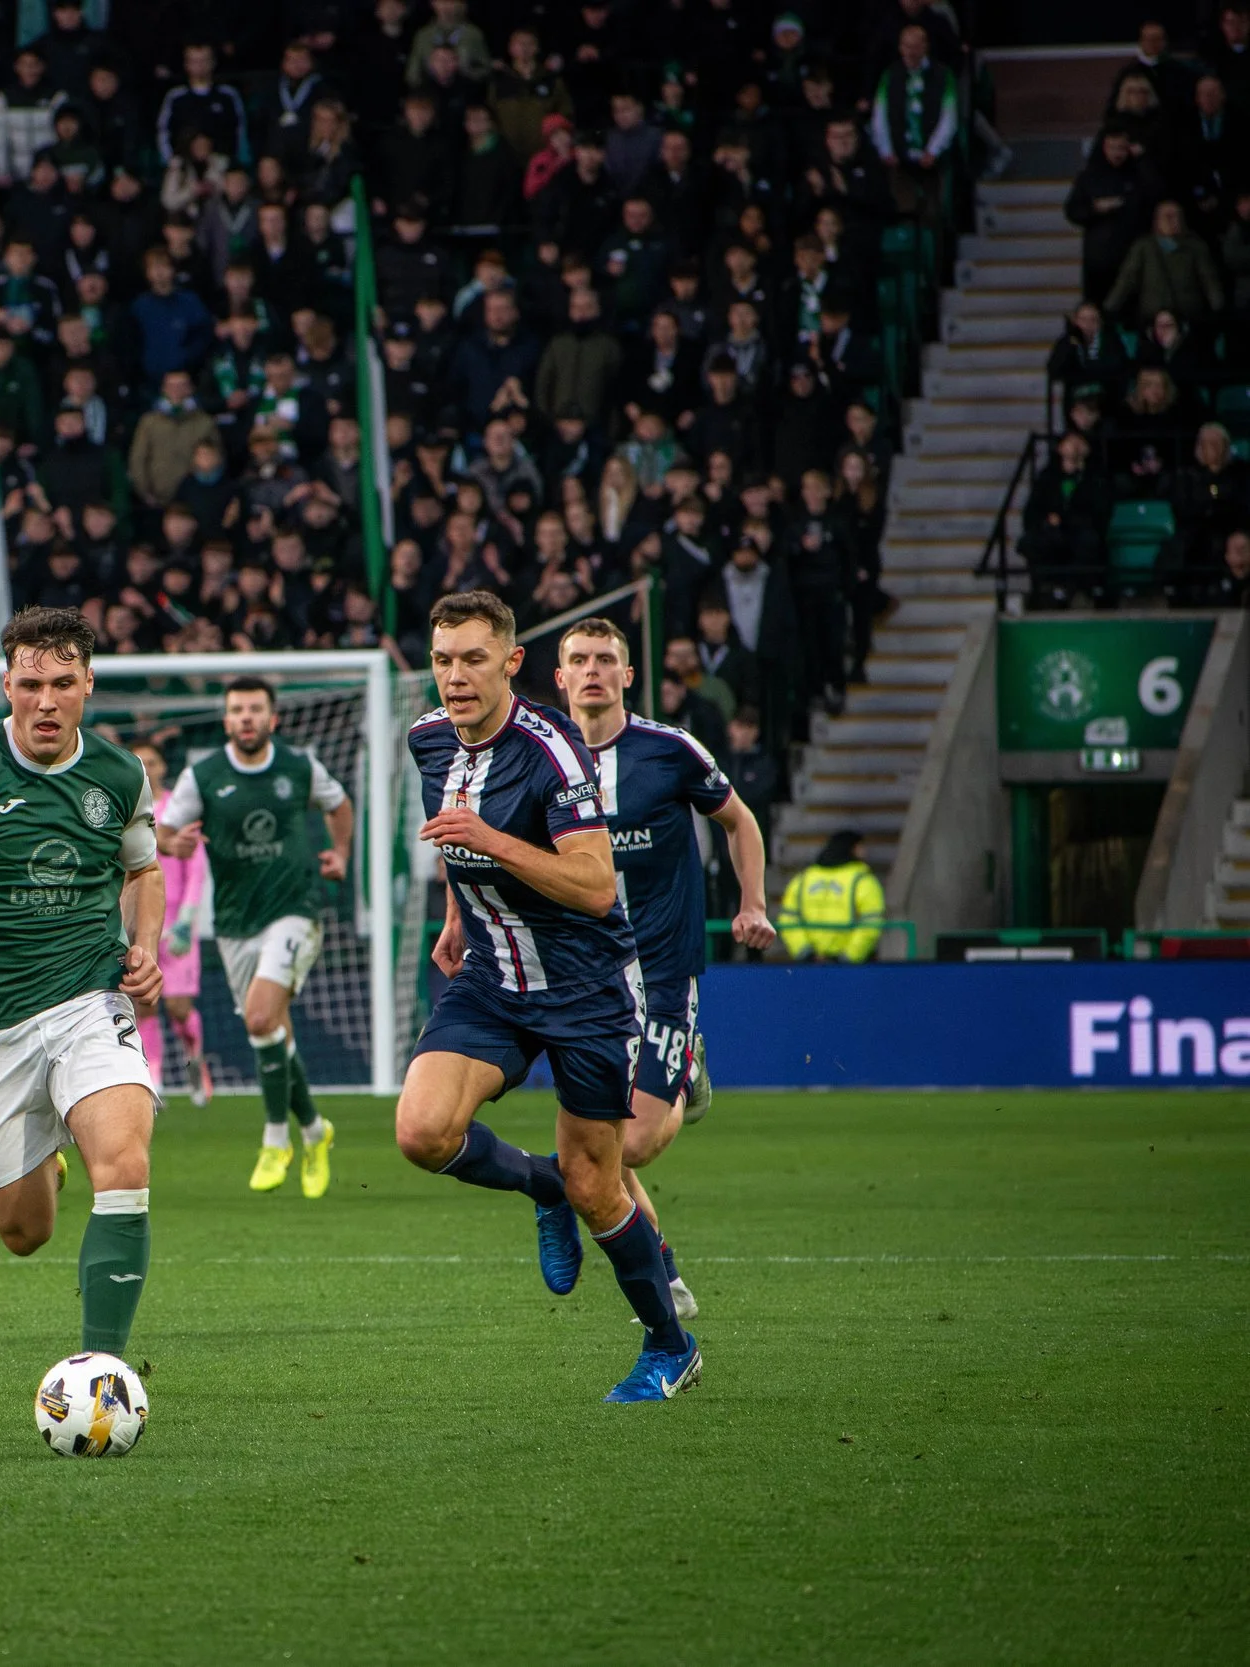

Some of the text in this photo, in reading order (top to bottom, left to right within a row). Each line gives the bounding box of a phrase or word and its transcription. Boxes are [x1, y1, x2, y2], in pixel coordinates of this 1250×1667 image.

[1138, 655, 1183, 716] 6
[10, 886, 82, 907] bevvy
[647, 1020, 686, 1070] 48
